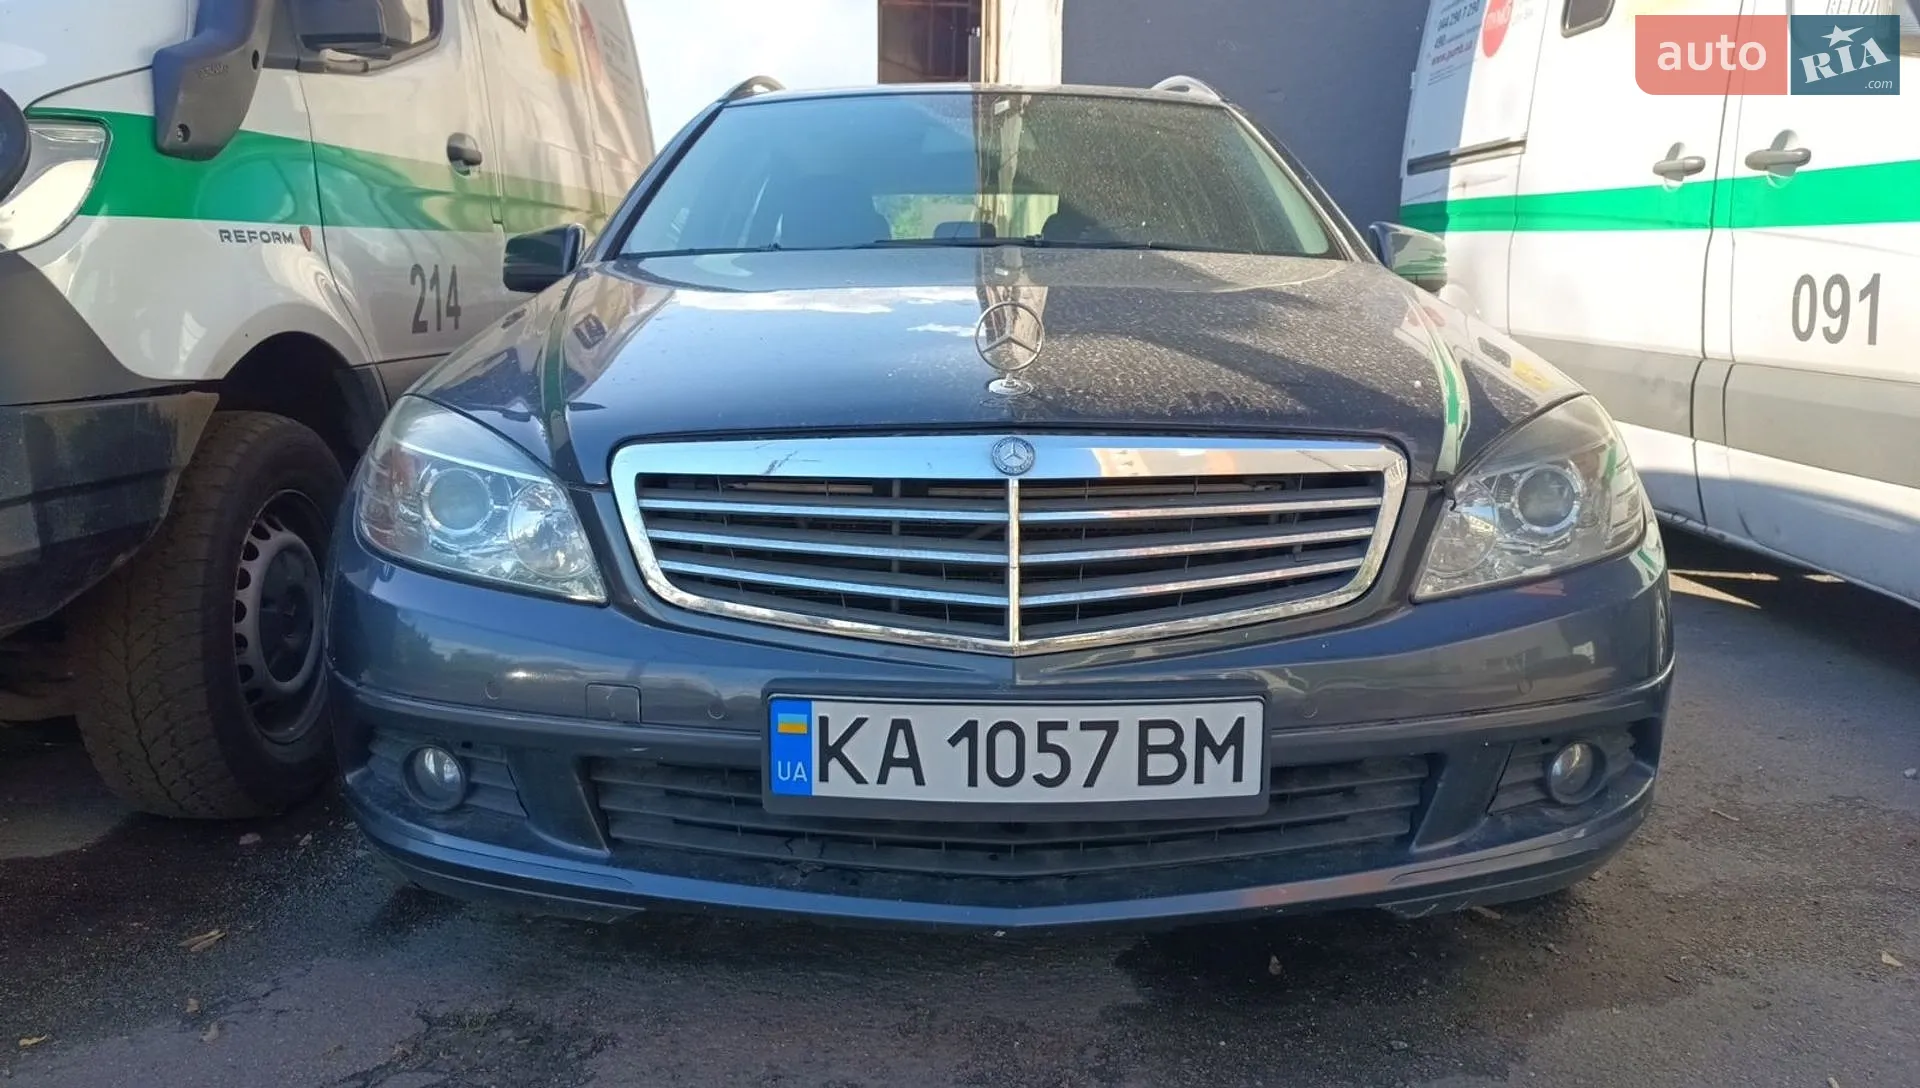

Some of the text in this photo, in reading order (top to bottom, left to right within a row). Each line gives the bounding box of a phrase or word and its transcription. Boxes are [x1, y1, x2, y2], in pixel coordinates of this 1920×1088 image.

[218, 228, 295, 244] REFORM
[410, 263, 462, 335] 214
[1791, 273, 1881, 346] 091
[777, 760, 808, 782] UA
[818, 715, 1246, 788] KA 1057 BM
